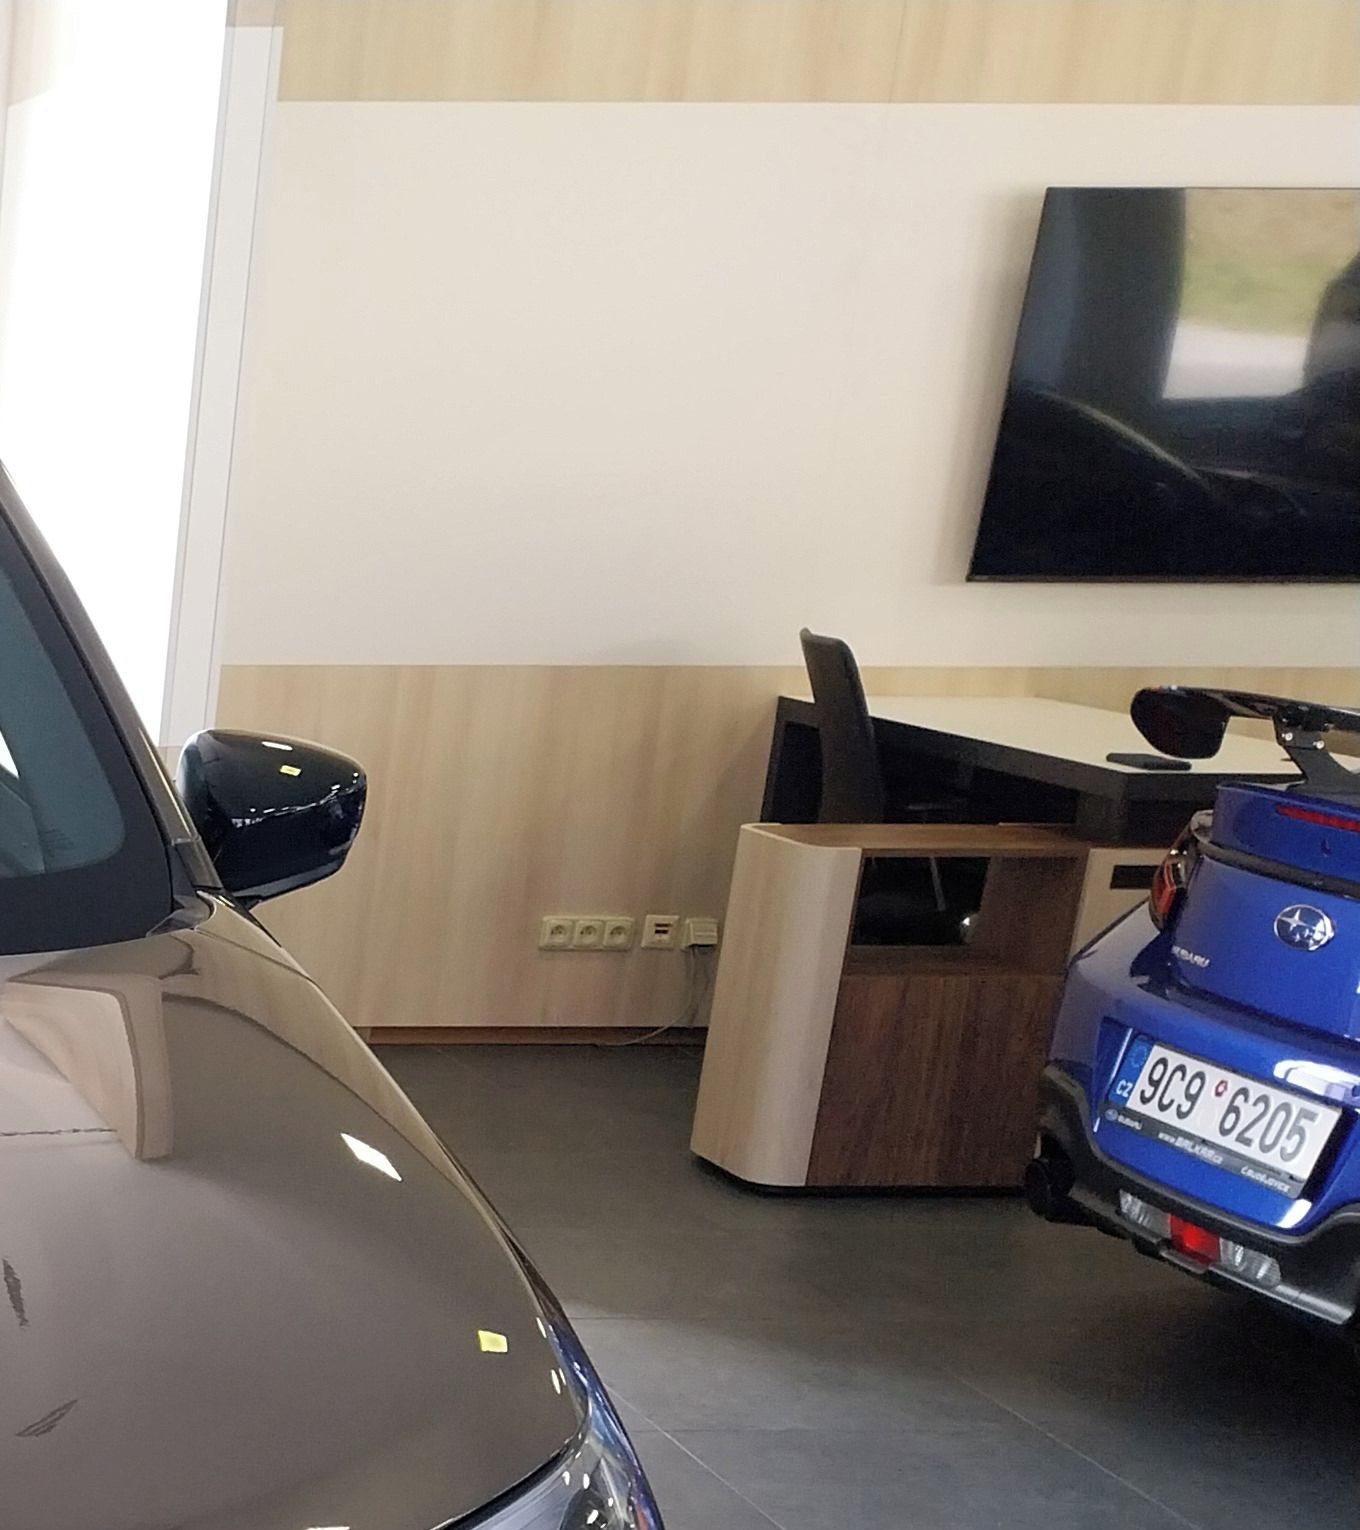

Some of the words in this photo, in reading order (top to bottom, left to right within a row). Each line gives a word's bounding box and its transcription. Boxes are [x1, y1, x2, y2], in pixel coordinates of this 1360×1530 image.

[1116, 1080, 1133, 1098] CZ
[1139, 1056, 1207, 1120] 9C9
[1218, 1086, 1319, 1163] 6205
